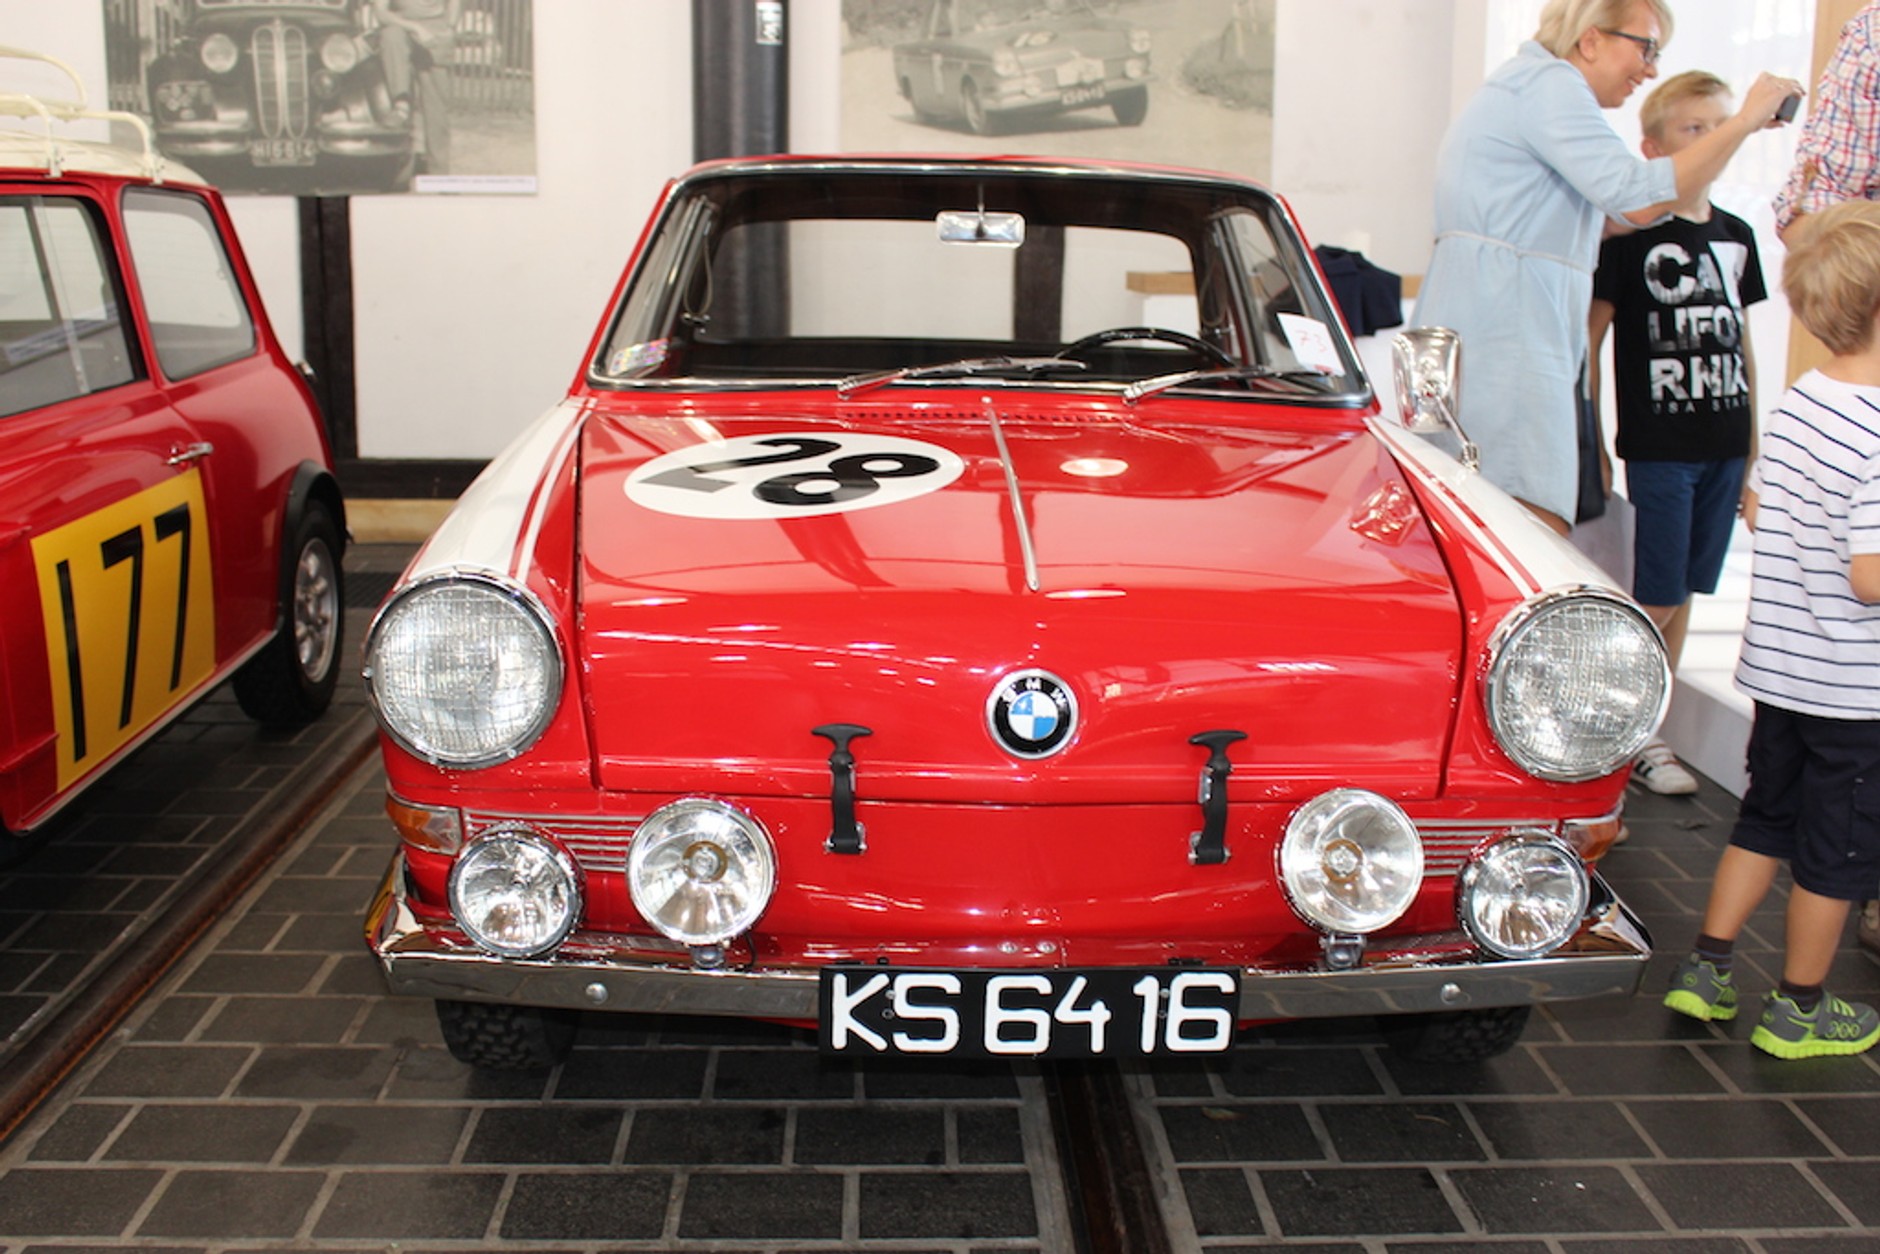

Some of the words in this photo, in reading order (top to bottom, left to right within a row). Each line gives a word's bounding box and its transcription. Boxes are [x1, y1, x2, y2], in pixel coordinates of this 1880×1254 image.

[638, 438, 940, 506] 28
[56, 502, 193, 764] 177
[1001, 677, 1067, 706] BMW
[832, 973, 961, 1052] KS
